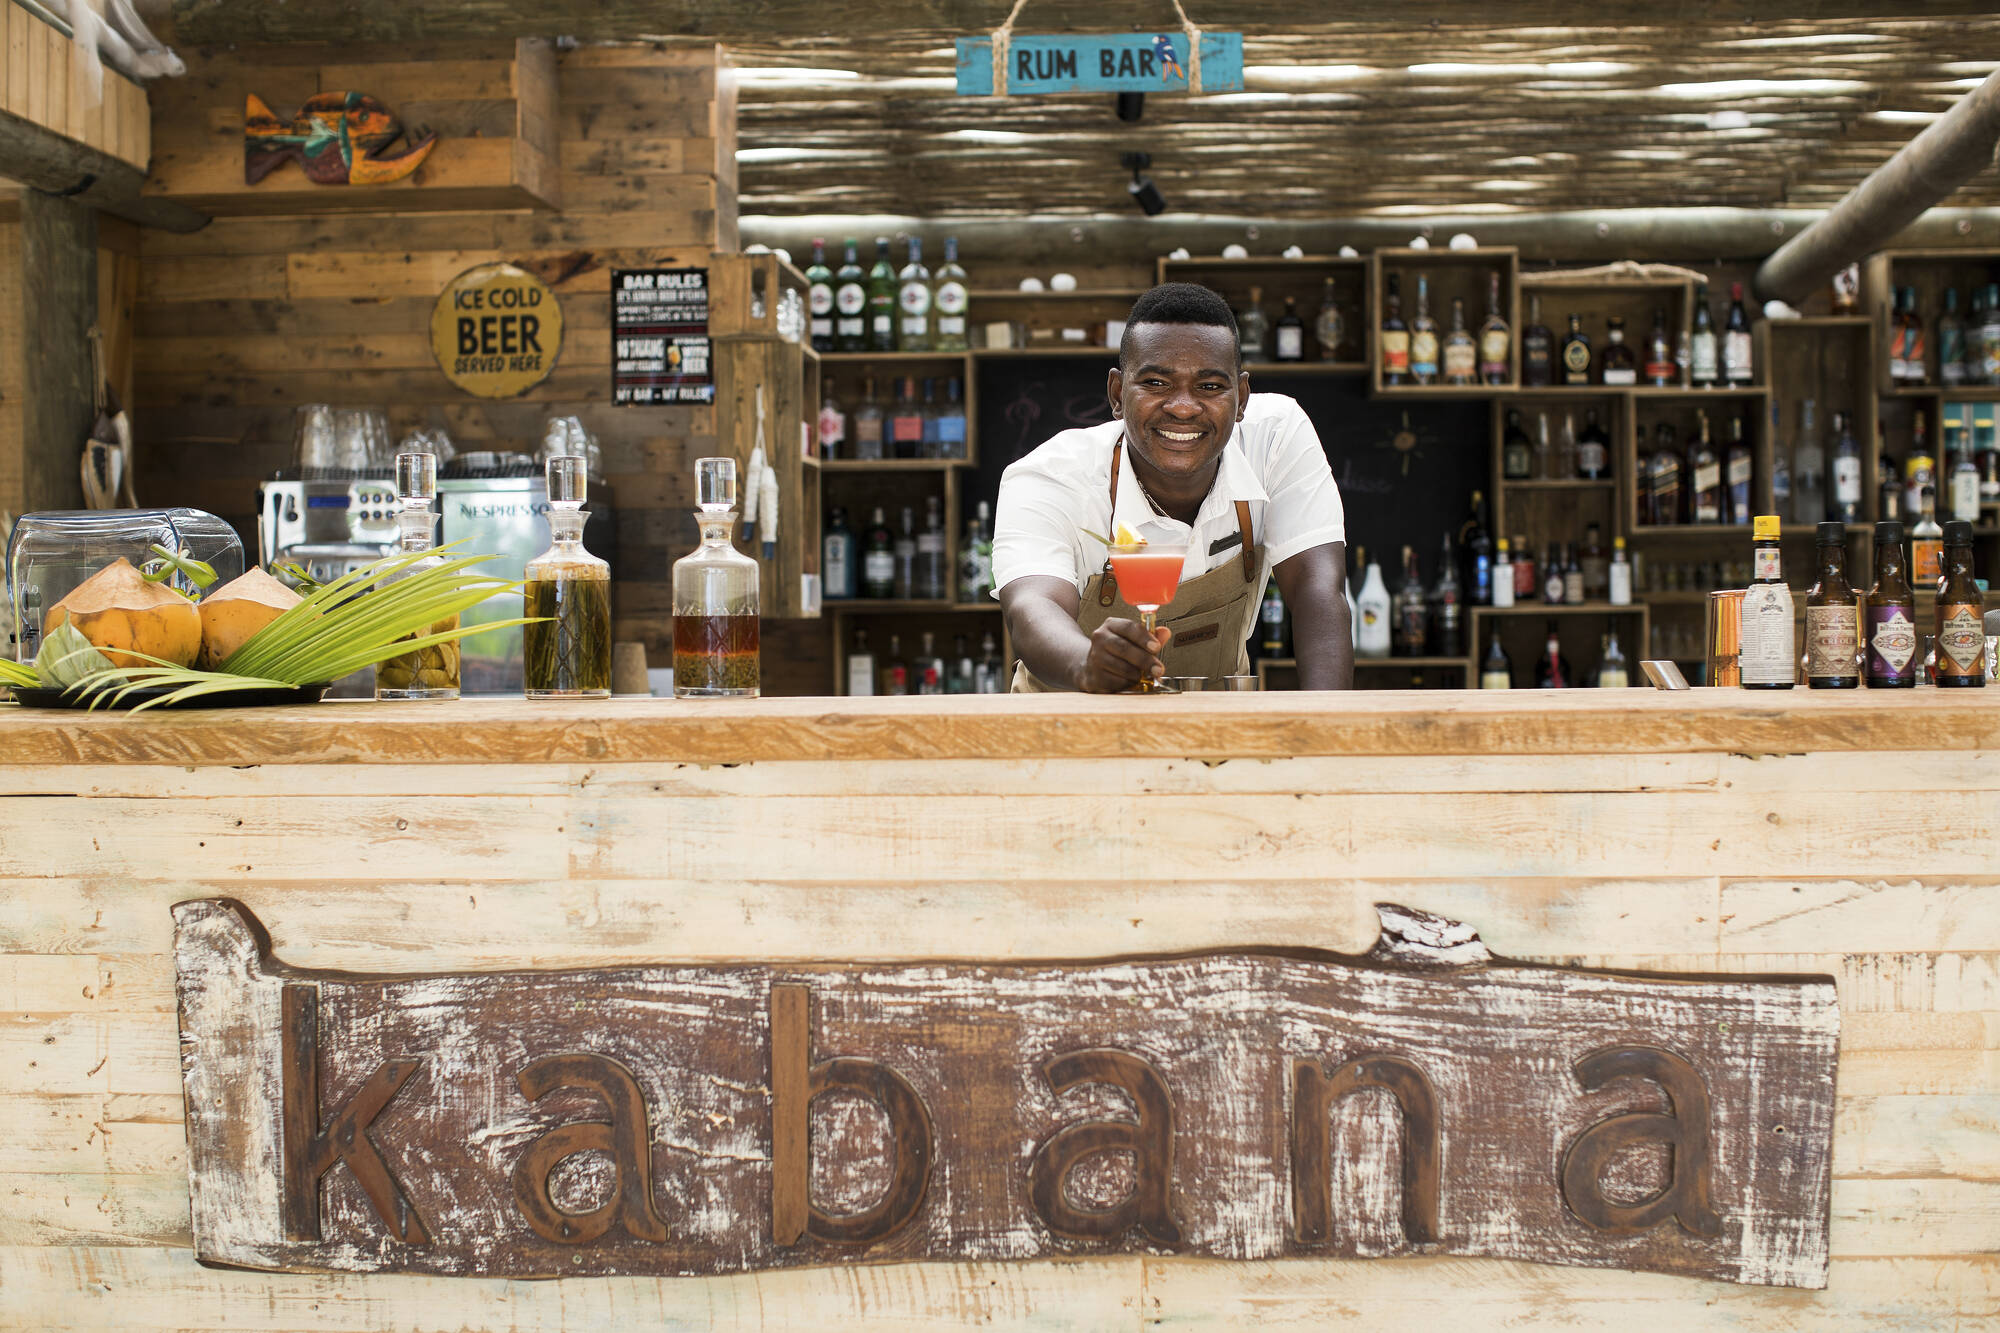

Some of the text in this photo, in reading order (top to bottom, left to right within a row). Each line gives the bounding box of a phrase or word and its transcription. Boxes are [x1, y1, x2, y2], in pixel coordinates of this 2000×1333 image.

[1017, 48, 1156, 80] RUM BAR
[623, 273, 703, 289] BAR RULES
[454, 286, 542, 310] ICE COLD
[457, 314, 543, 354] BEER
[454, 354, 542, 375] SERVED HERE
[460, 502, 550, 519] NESPRESSO
[281, 981, 1721, 1246] kabana
